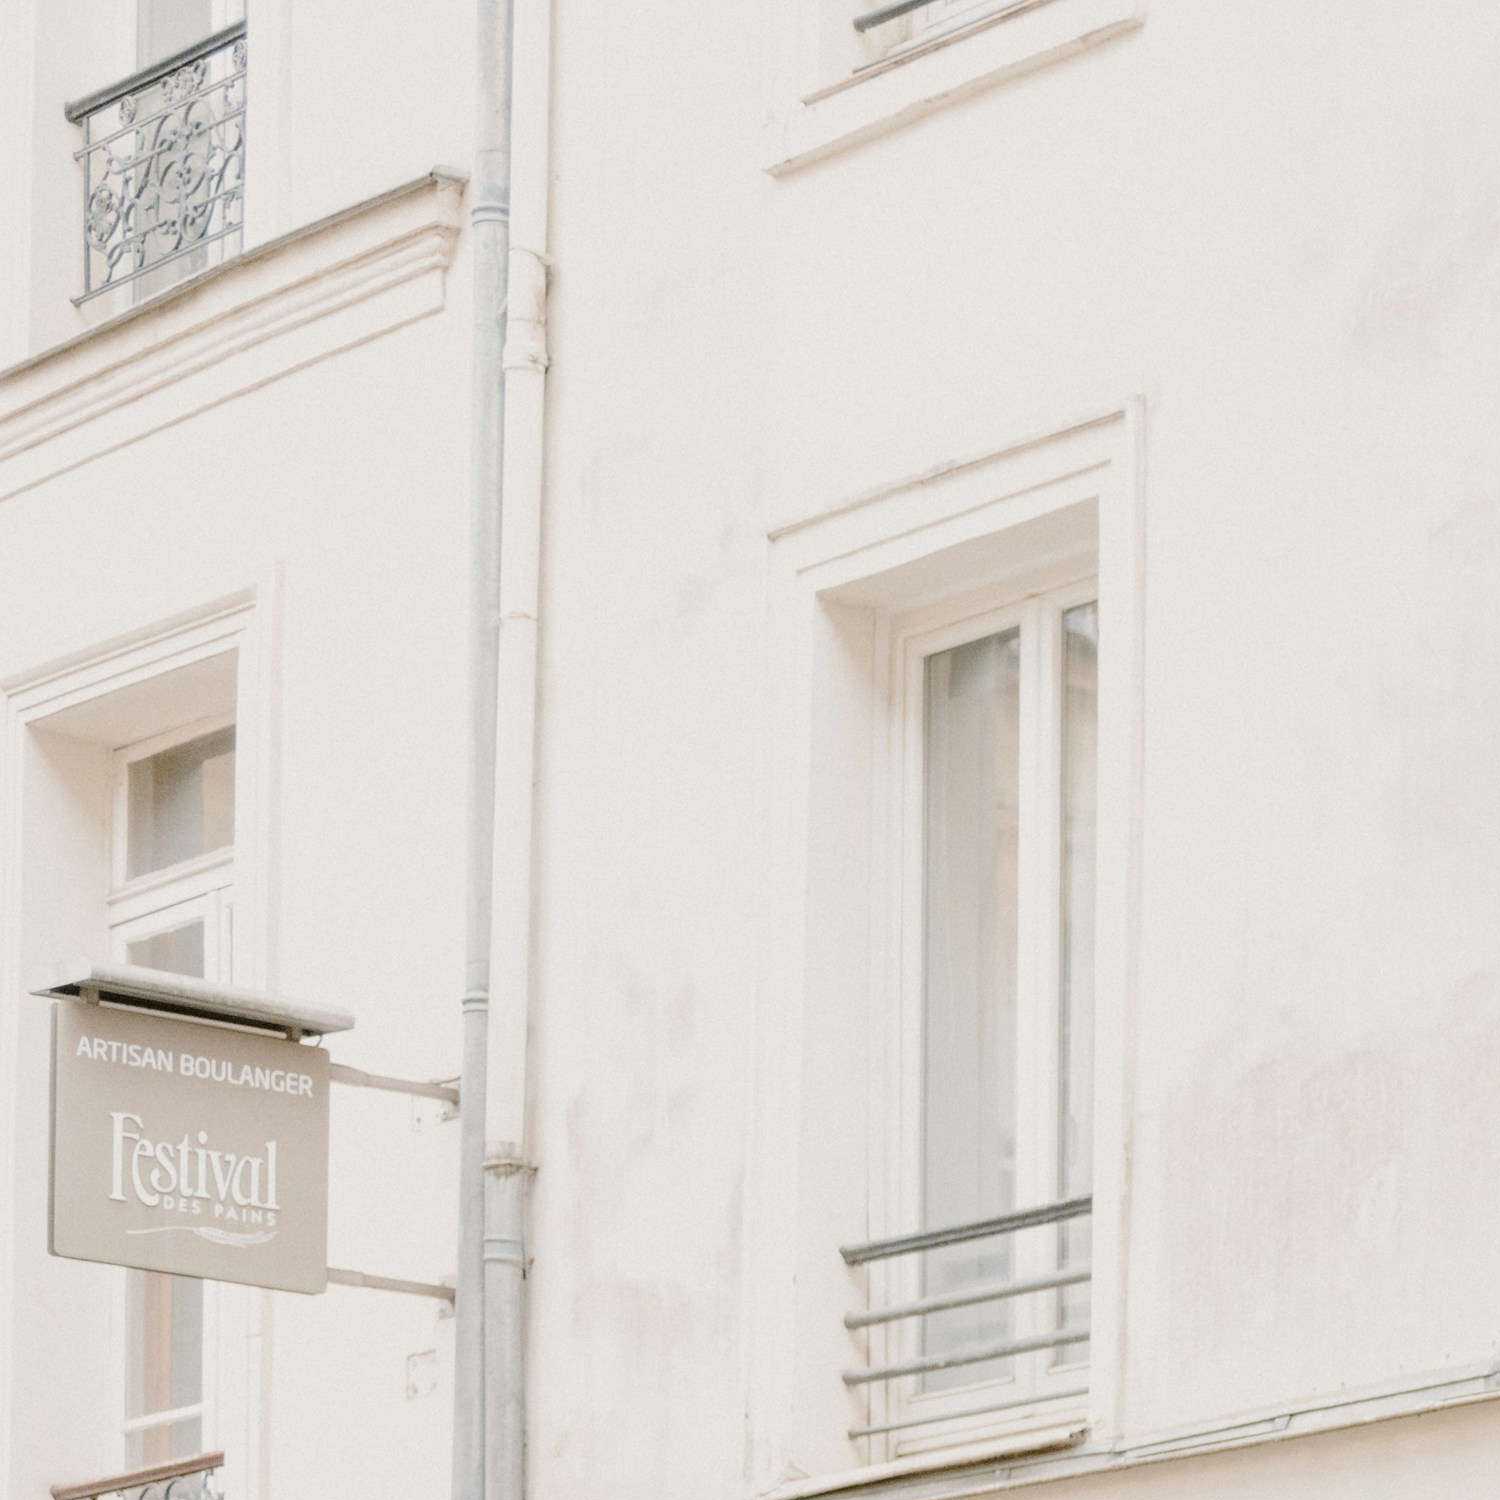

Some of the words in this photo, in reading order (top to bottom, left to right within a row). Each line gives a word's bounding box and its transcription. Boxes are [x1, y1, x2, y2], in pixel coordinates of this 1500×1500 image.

[77, 1036, 173, 1073] ARTISAN
[180, 1052, 313, 1098] BOULANGER
[108, 1111, 280, 1211] Festival
[162, 1195, 203, 1214] DES
[214, 1202, 277, 1227] PAINS
